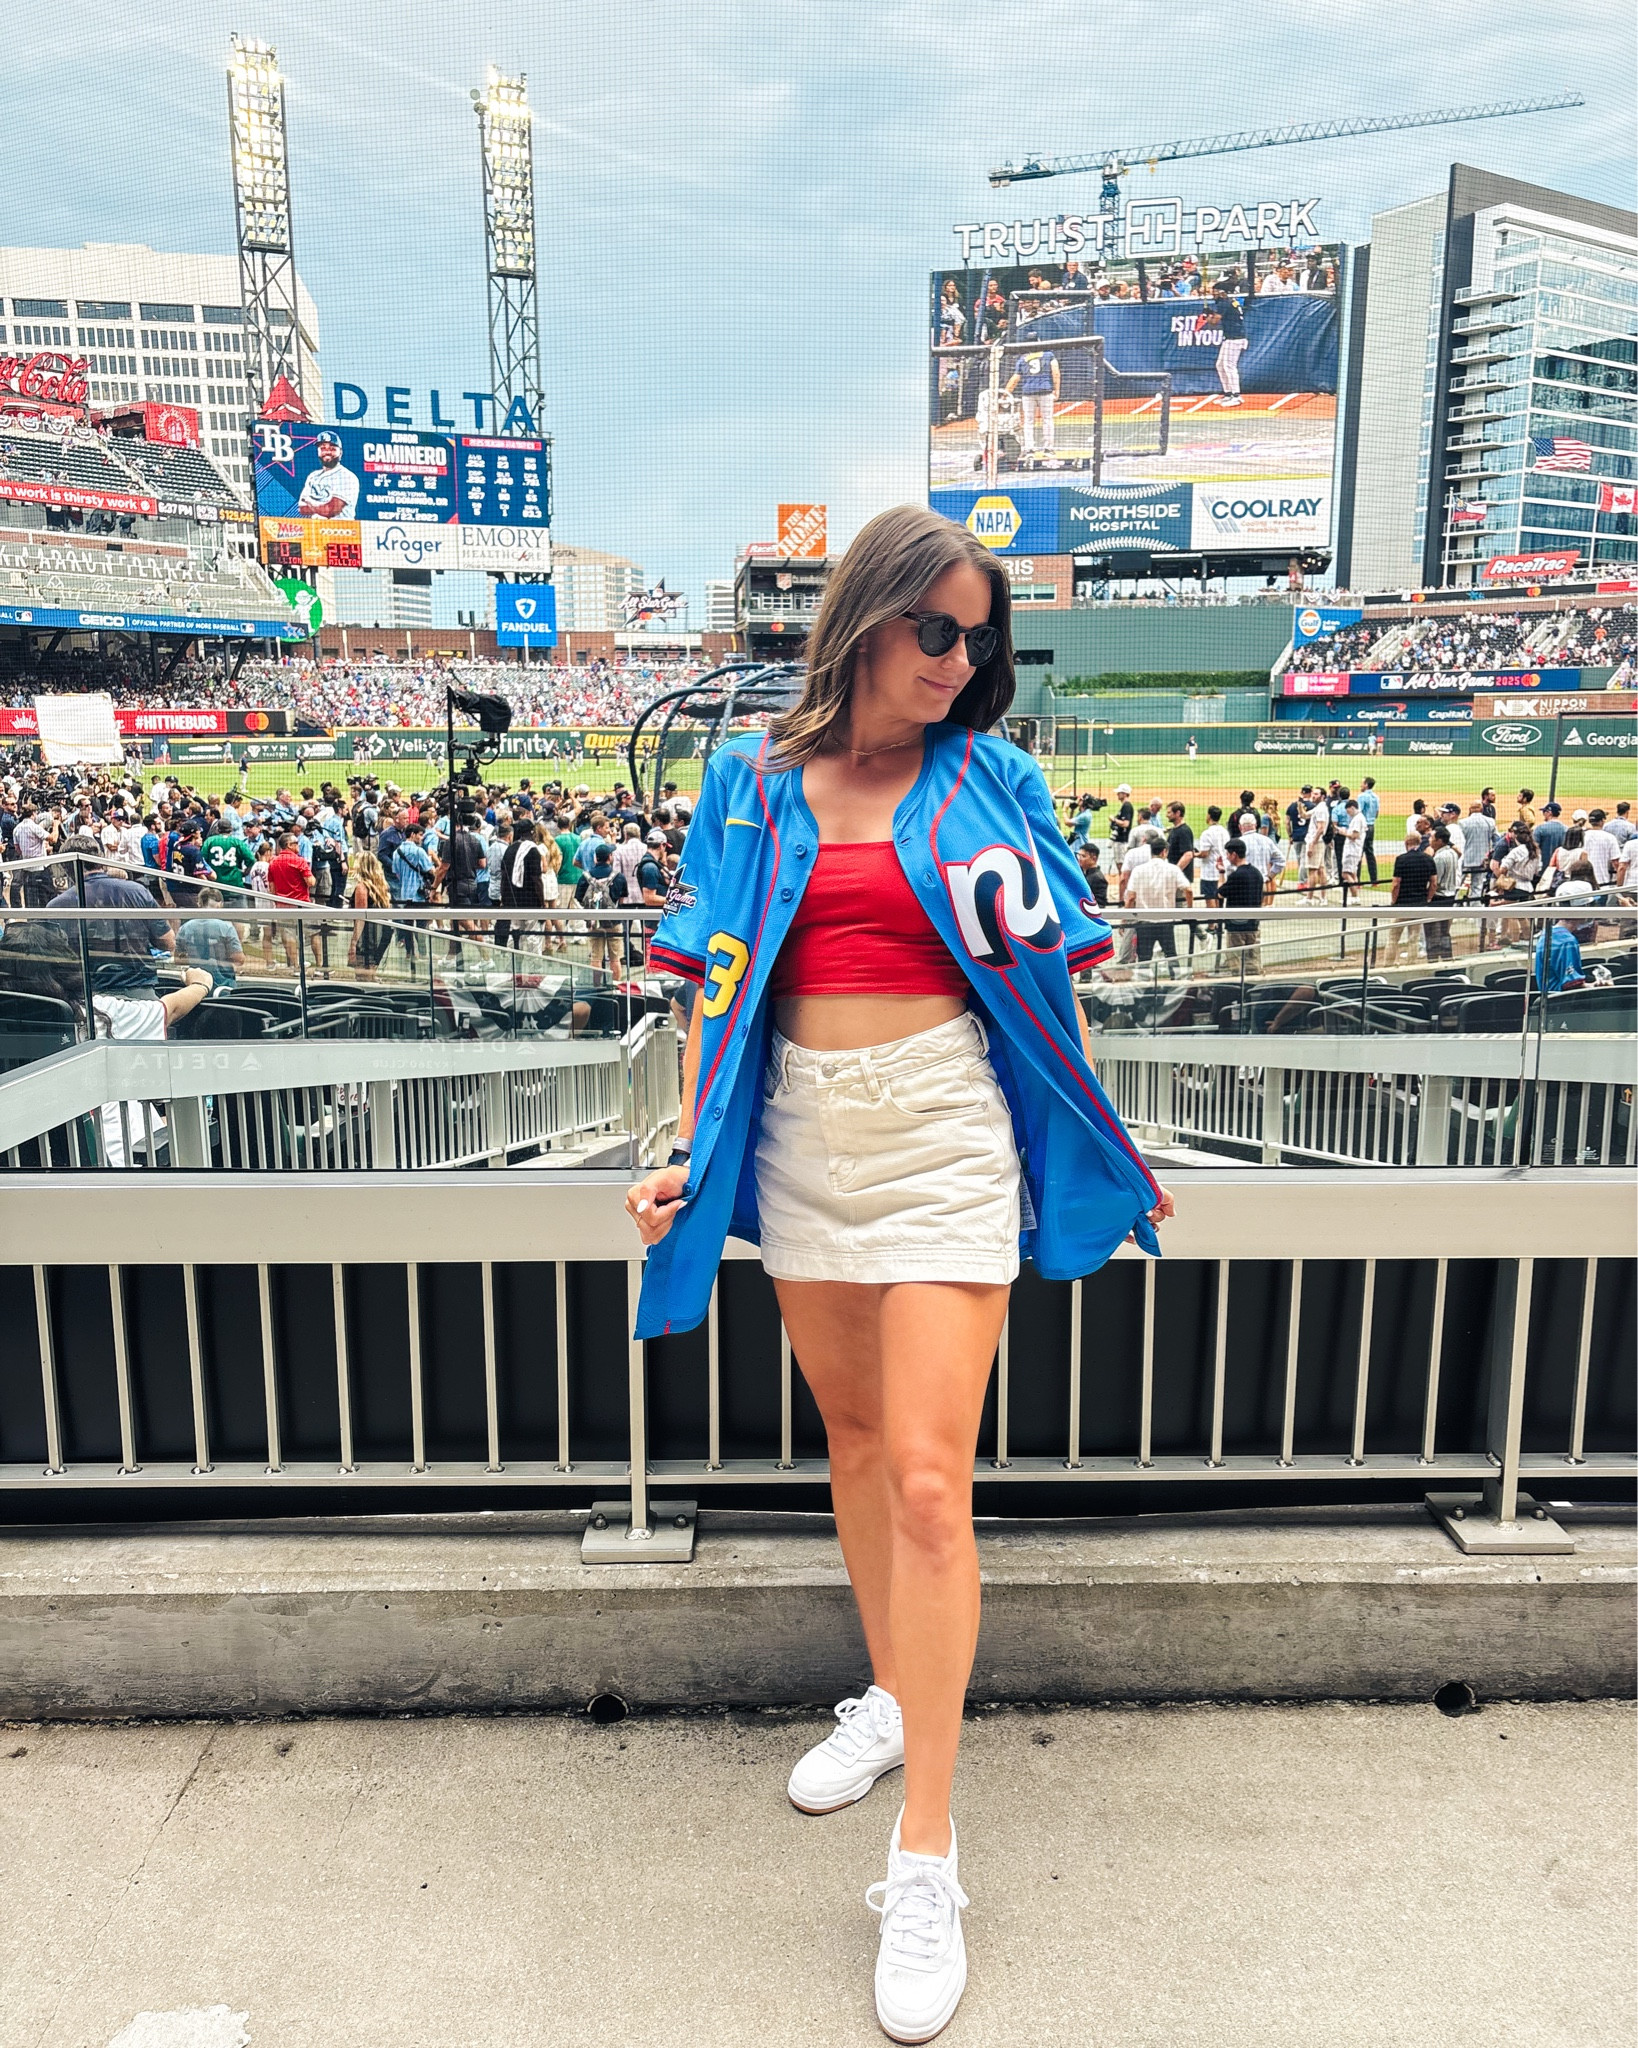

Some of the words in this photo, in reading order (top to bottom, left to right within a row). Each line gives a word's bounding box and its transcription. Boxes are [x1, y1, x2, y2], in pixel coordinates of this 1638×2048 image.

[953, 213, 1116, 260] TRUIST
[1195, 197, 1322, 244] PARK
[333, 381, 537, 433] DELTA
[255, 423, 295, 462] TB
[363, 443, 447, 466] CAMINERO
[13, 486, 48, 500] work
[50, 489, 61, 501] is
[63, 490, 104, 508] thirsty
[106, 497, 138, 510] work
[366, 494, 395, 504] SANTO
[1069, 503, 1181, 522] NORTHSIDE
[1212, 497, 1323, 519] COOLRAY
[782, 509, 804, 529] THE
[975, 511, 1013, 534] NAPA
[1089, 519, 1160, 532] HOSPITAL
[461, 526, 545, 548] EMORY
[778, 504, 827, 556] HOME
[328, 543, 361, 559] 264
[376, 526, 442, 563] Kroger
[38, 547, 113, 575] AARON
[328, 558, 361, 566] MILLION
[462, 549, 543, 561] HEALTHCARE
[1489, 556, 1568, 575] RaceTrac
[639, 595, 661, 608] Star
[79, 614, 125, 626] GEICO
[131, 618, 159, 627] OFFICIAL
[160, 620, 186, 629] PARTNER
[212, 622, 240, 631] BASEBALL
[501, 622, 552, 634] FANDUEL
[1301, 618, 1320, 627] Gulf
[1403, 673, 1430, 690] All
[1429, 673, 1458, 690] Star
[1458, 674, 1494, 690] Game
[1496, 676, 1520, 686] 2025
[1540, 698, 1587, 708] NIPPON
[135, 714, 218, 731] #HITTHEBUDS
[1491, 725, 1531, 743] Ford
[1586, 732, 1638, 748] Georgia
[261, 744, 288, 752] TYM
[486, 733, 557, 755] finity
[1420, 742, 1453, 751] National
[210, 846, 236, 867] 34
[669, 888, 696, 906] Game
[702, 929, 750, 1020] 3
